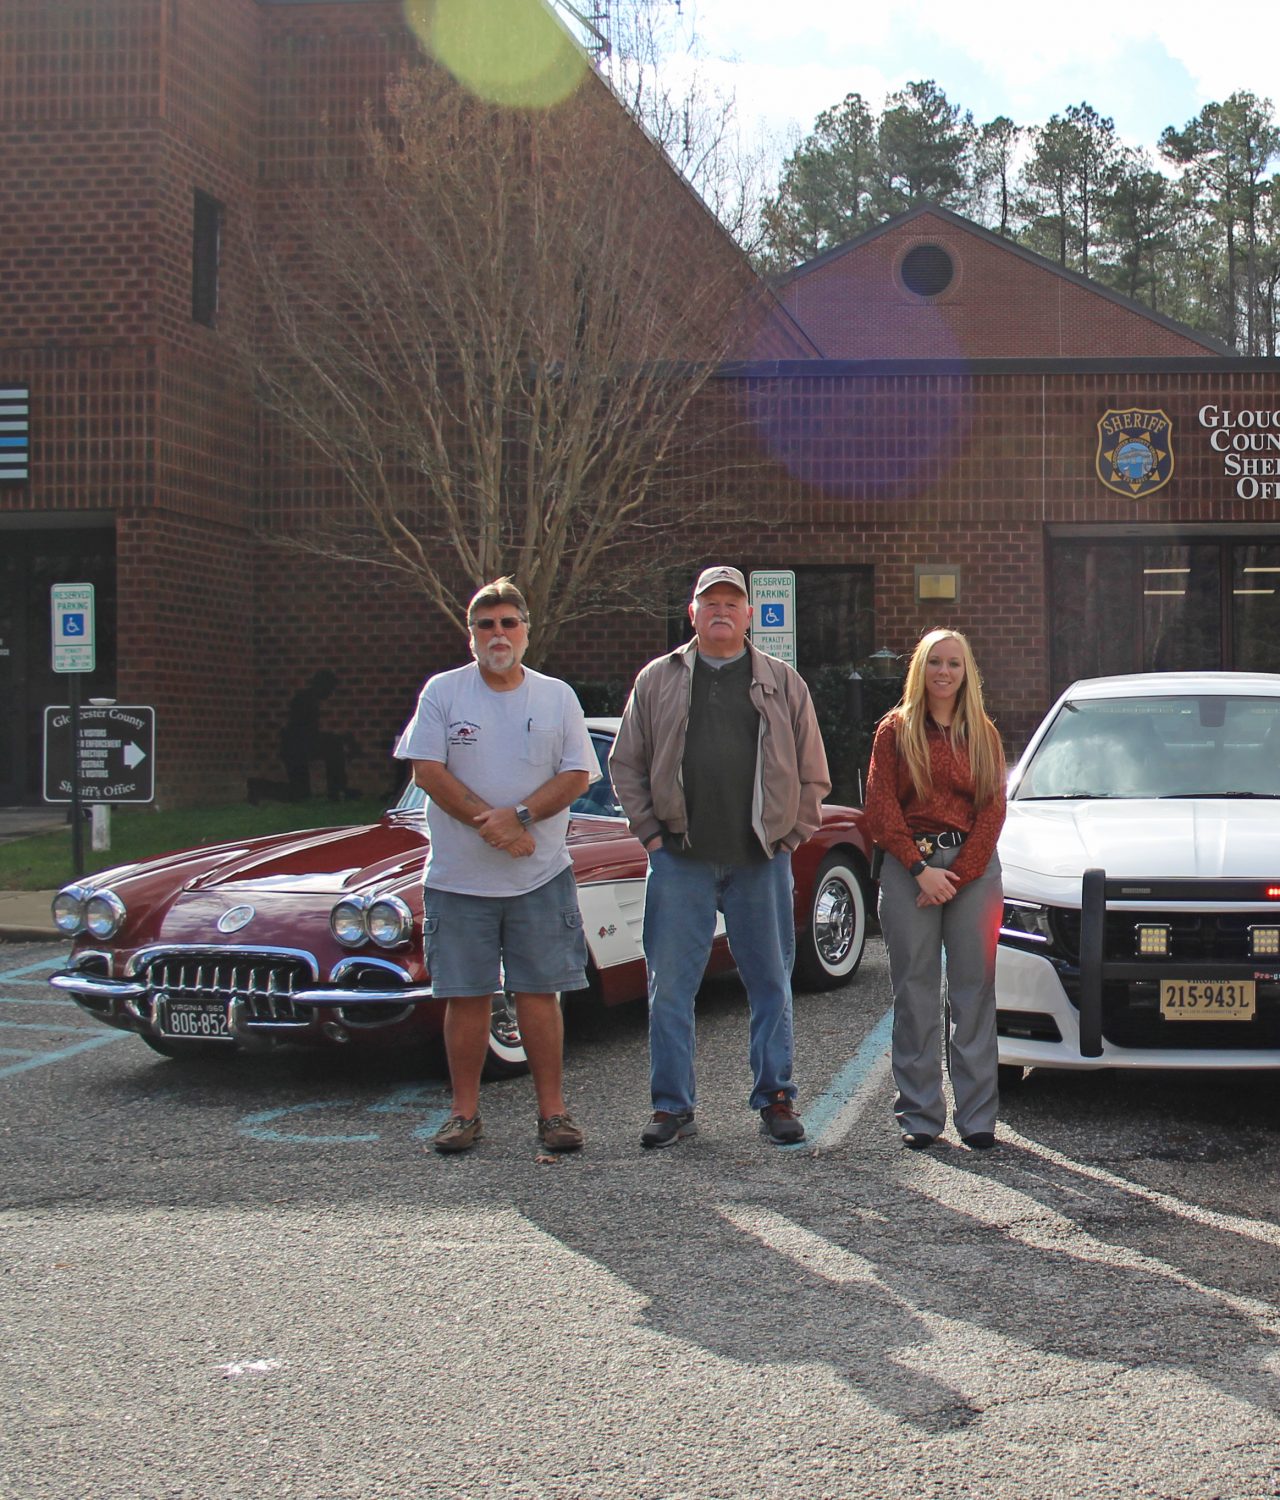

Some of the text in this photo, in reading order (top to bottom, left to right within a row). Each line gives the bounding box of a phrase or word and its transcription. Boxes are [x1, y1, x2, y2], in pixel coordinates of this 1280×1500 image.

[1102, 413, 1167, 436] SHERIFF
[753, 577, 792, 586] RESERVED
[756, 590, 790, 598] PARKING
[57, 602, 89, 611] PARKING
[109, 709, 145, 730] County
[103, 783, 136, 797] Office
[171, 1004, 225, 1012] VIRGINIA 1960
